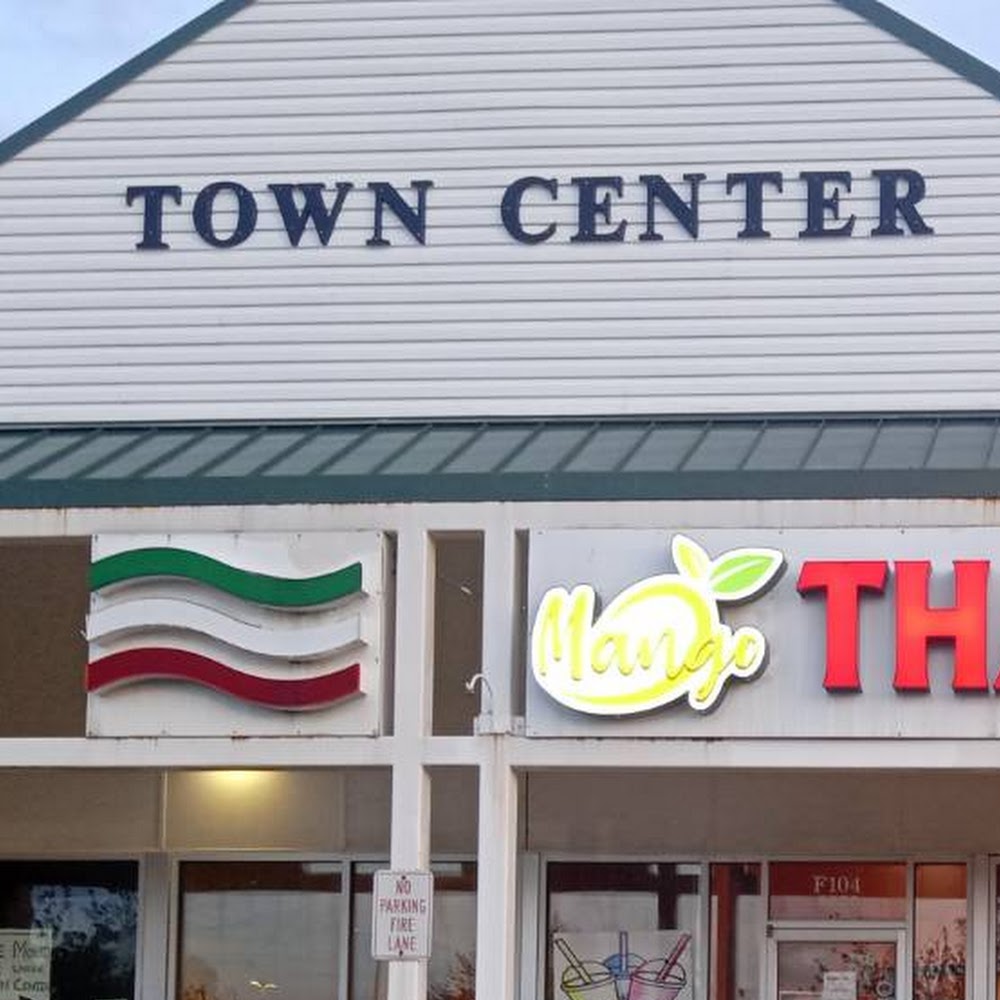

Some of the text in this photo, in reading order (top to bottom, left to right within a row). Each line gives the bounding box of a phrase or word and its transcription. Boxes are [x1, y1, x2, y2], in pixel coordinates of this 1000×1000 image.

[125, 167, 936, 251] TOWN CENTER
[536, 588, 761, 704] Mango
[395, 880, 412, 895] NO
[812, 876, 861, 894] F104
[379, 898, 427, 914] PARKING
[390, 917, 417, 933] FIRE
[388, 935, 417, 952] LANE
